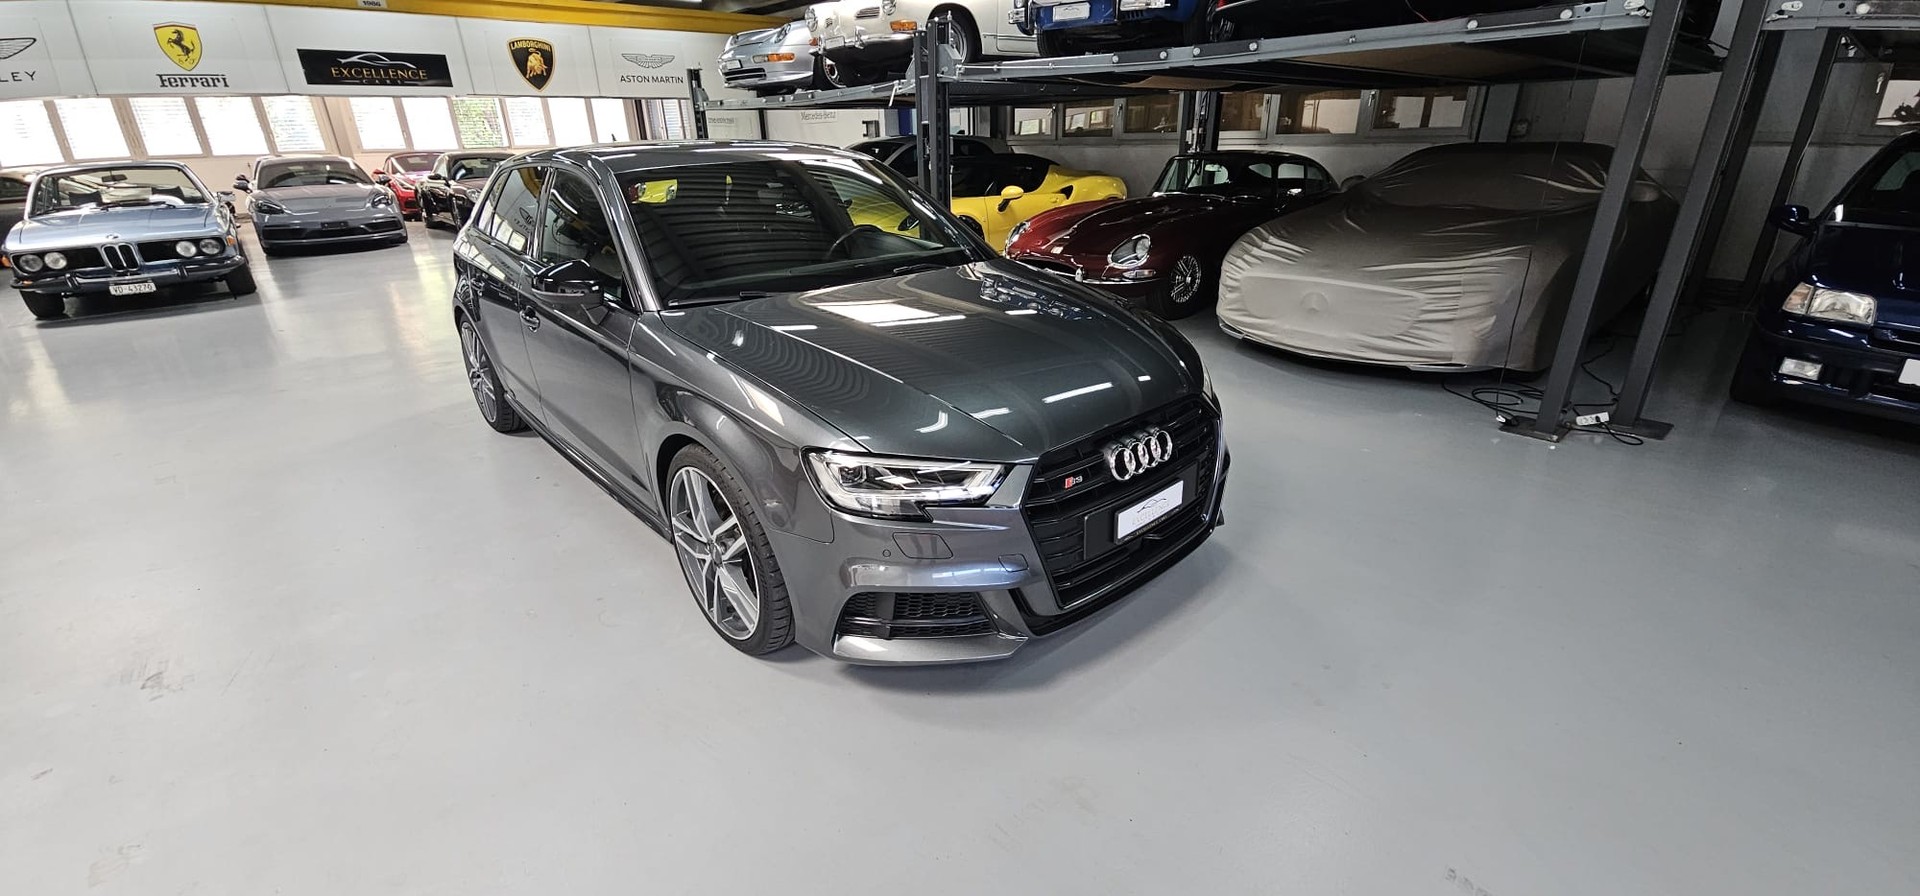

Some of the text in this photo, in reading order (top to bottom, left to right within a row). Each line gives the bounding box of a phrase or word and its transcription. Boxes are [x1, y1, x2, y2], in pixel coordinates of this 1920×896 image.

[330, 67, 428, 80] EXCELLENCE
[620, 74, 684, 84] ASTON MARTIN
[155, 74, 230, 88] Ferrari
